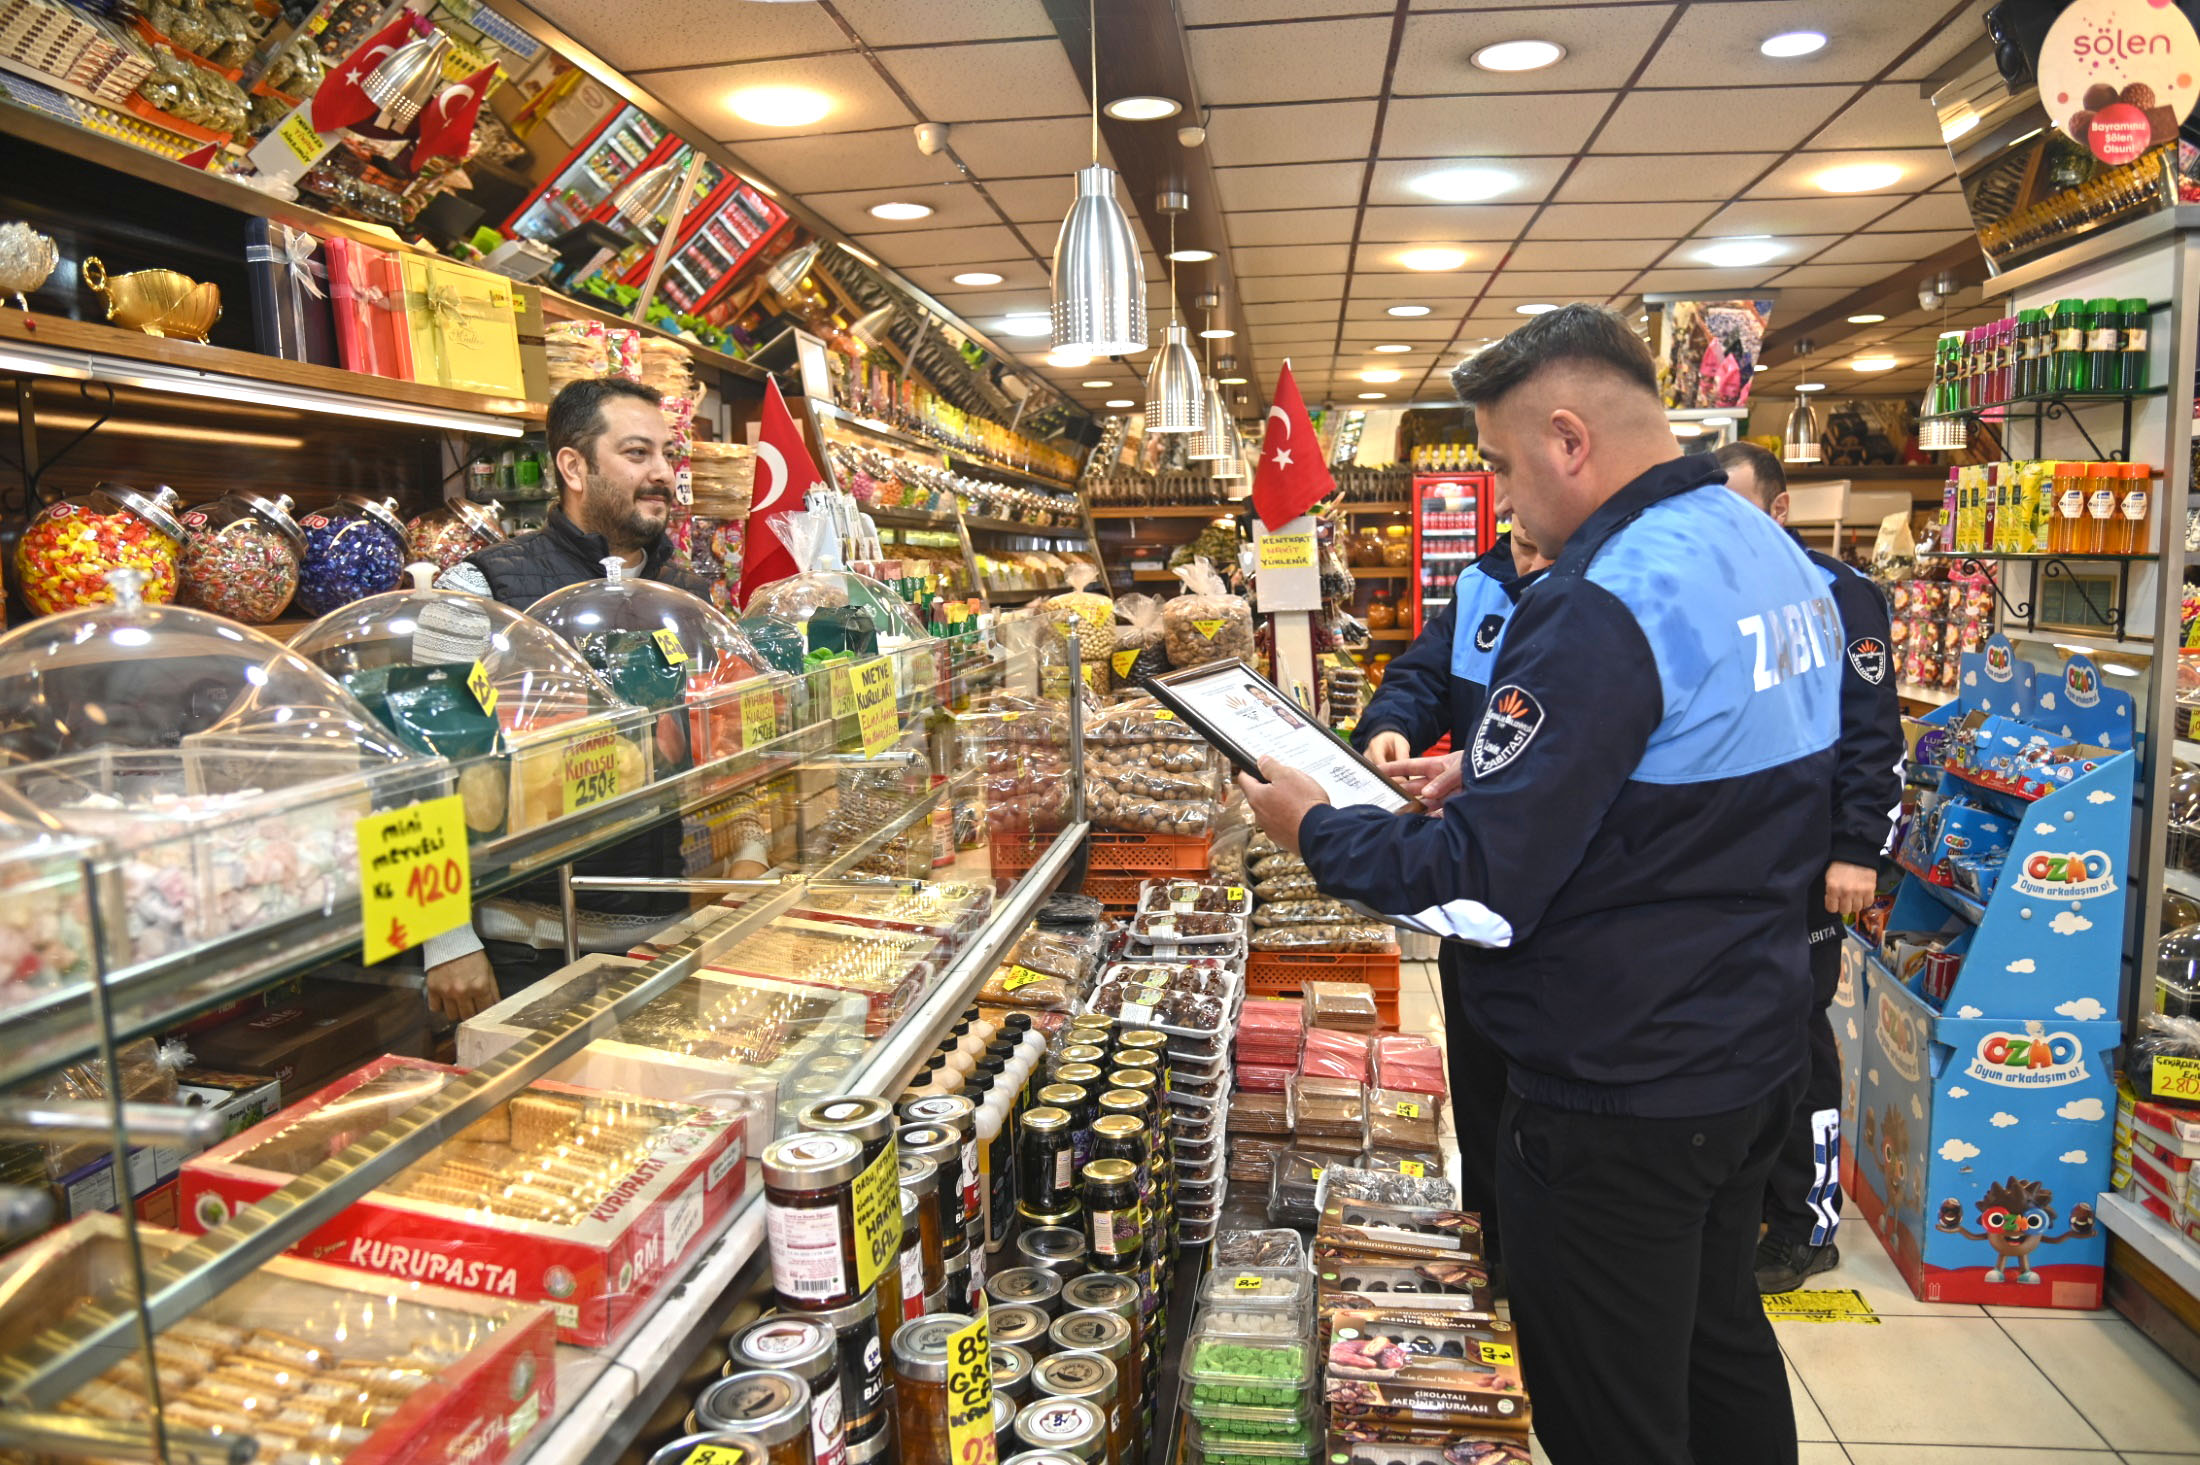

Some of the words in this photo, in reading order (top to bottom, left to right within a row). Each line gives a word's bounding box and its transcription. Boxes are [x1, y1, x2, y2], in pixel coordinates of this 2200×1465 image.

[2073, 28, 2172, 63] şölen
[1736, 597, 1844, 692] ZABITA
[565, 752, 615, 782] KURUSU
[1482, 729, 1528, 771] ZABITASI
[406, 857, 463, 908] 120
[2027, 853, 2107, 885] OZMO
[2020, 880, 2044, 896] Oyun
[2046, 885, 2099, 897] arkadaşım
[1983, 1036, 2076, 1070] OZMO
[1974, 1063, 2003, 1081] Oyun
[2005, 1068, 2067, 1084] arkadaşım
[350, 1236, 518, 1296] KURUPASTA
[871, 1230, 899, 1268] BAL
[1414, 1390, 1467, 1402] ÇİKOLATALI
